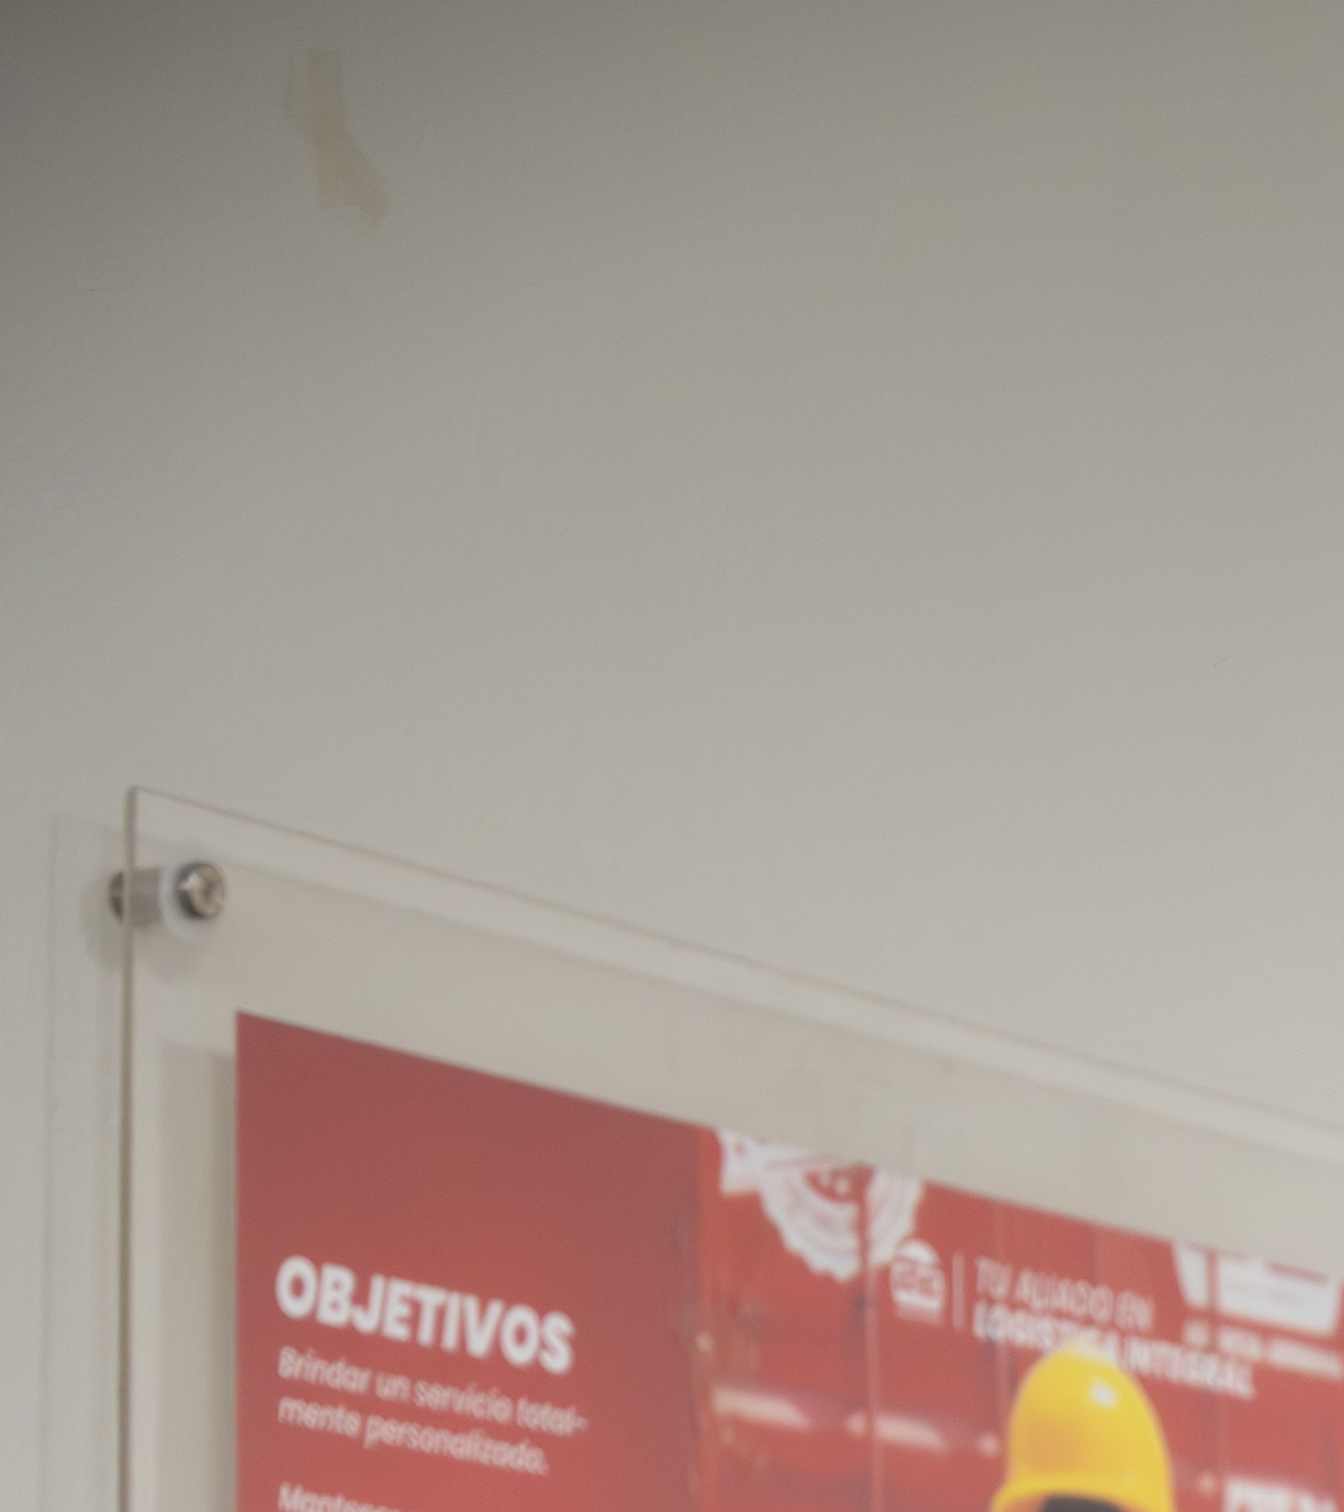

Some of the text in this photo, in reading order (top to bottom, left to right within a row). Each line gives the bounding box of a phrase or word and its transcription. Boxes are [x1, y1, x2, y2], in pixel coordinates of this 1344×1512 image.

[275, 1255, 575, 1375] OBJETIVOS
[278, 1345, 372, 1394] Brindar
[375, 1371, 409, 1401] un
[414, 1377, 513, 1424] servicio
[1127, 1334, 1256, 1400] INTEGRAL
[278, 1396, 362, 1438] mente
